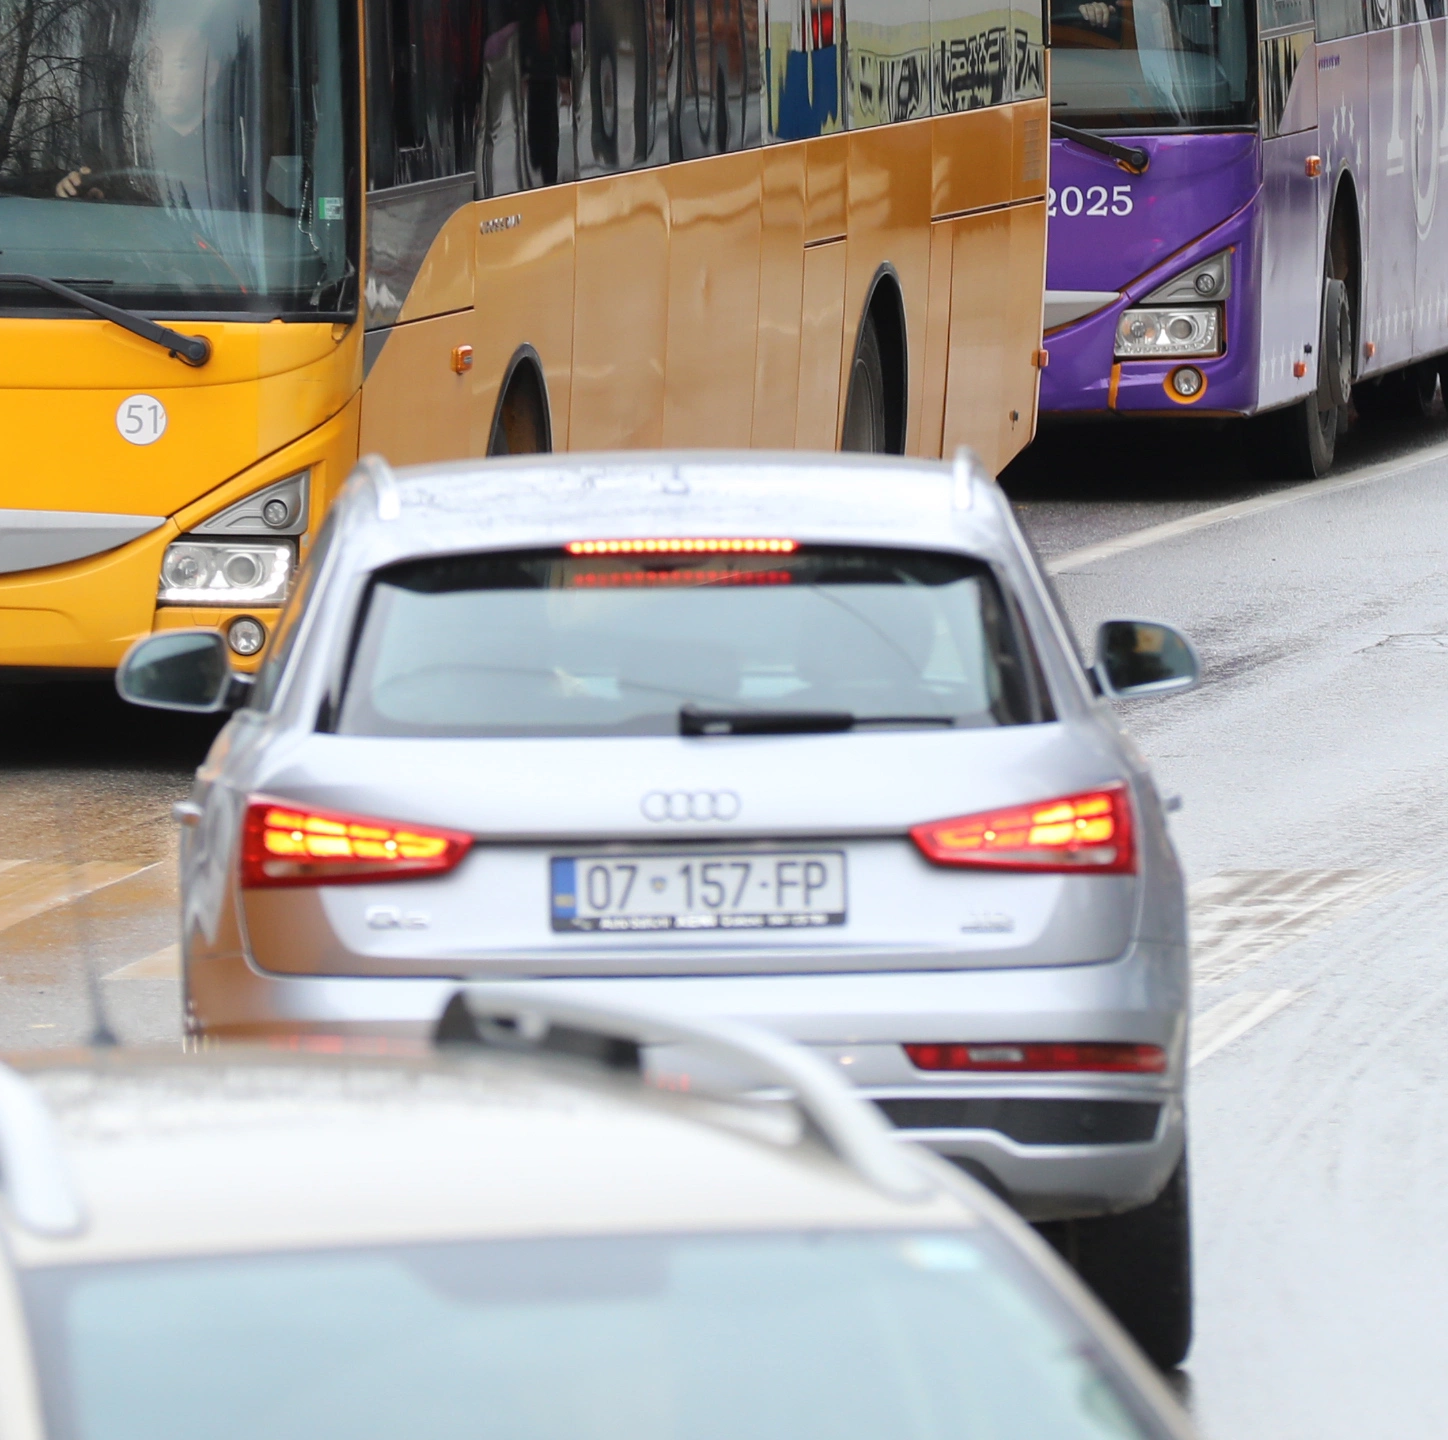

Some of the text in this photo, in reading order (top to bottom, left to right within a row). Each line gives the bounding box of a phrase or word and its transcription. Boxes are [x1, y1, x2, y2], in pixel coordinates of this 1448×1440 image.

[125, 404, 158, 435] 51
[586, 860, 828, 911] 07 157-FP
